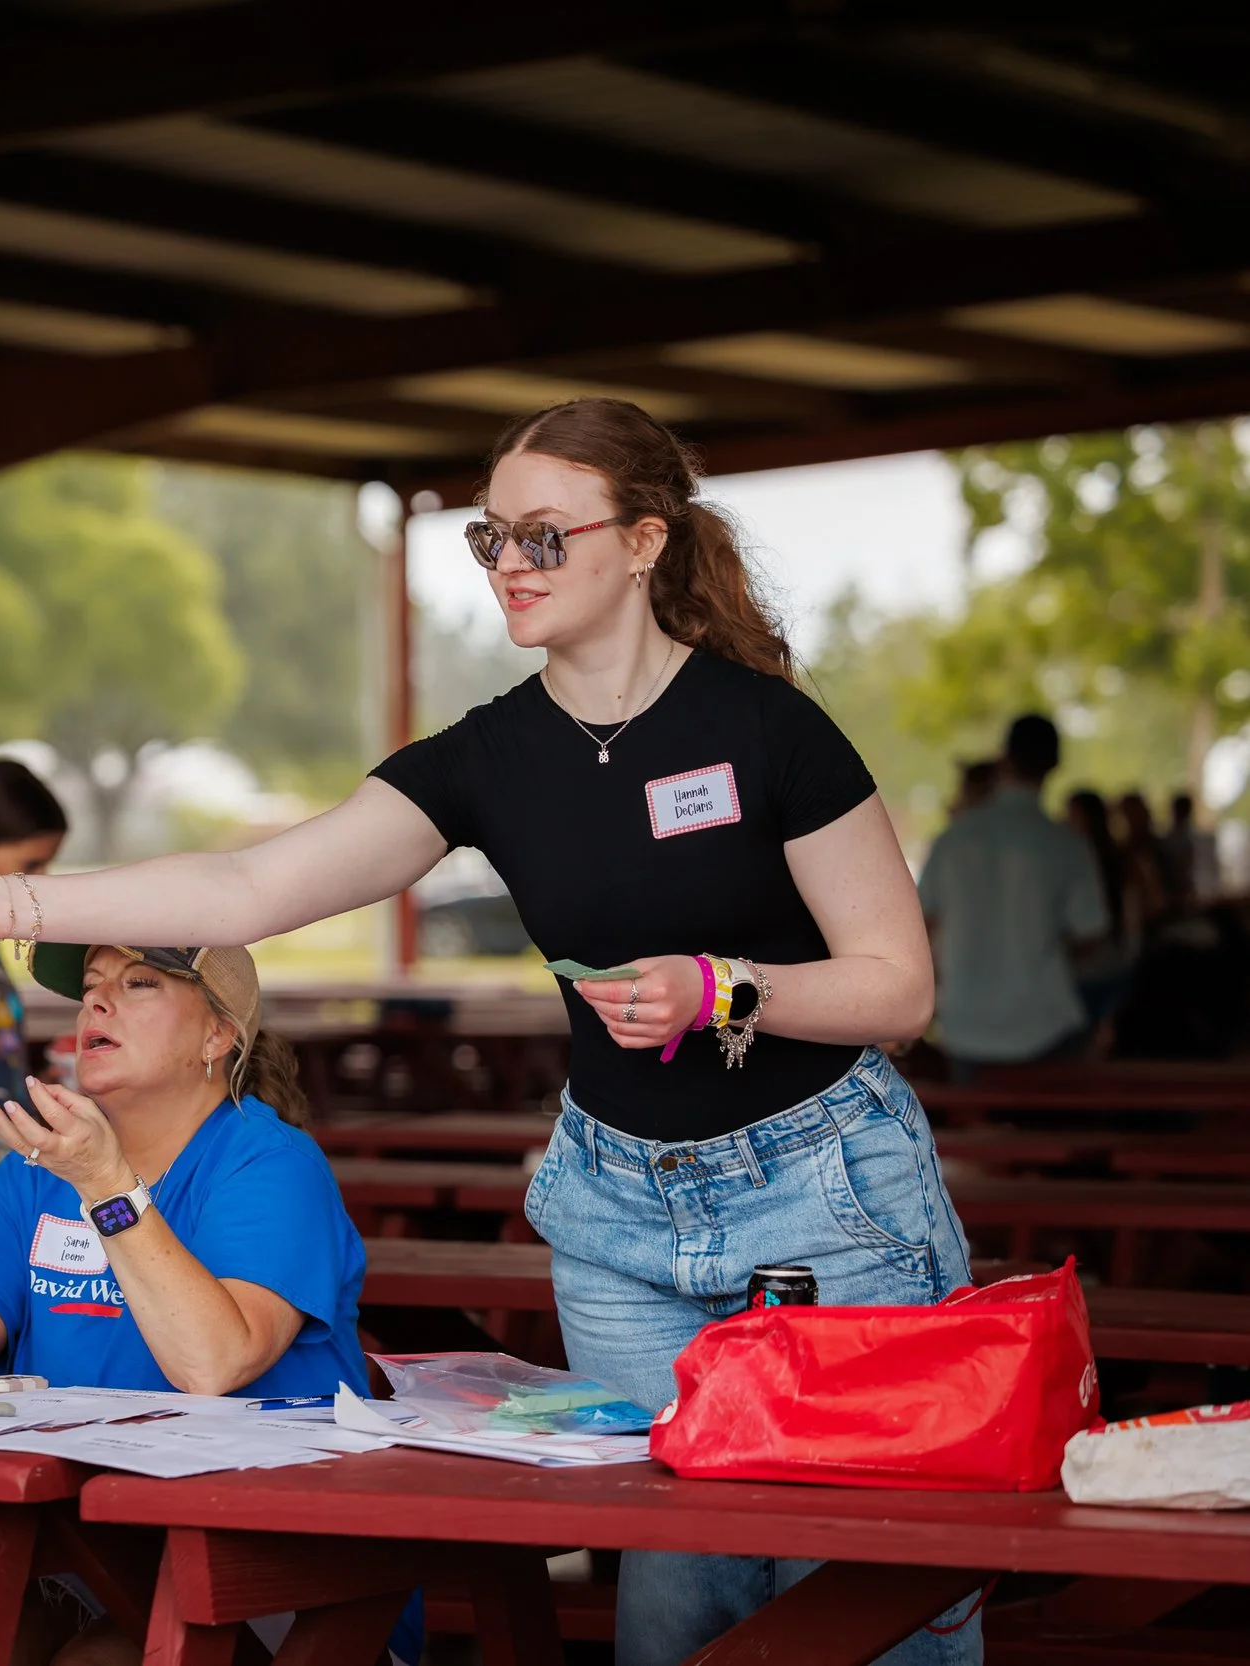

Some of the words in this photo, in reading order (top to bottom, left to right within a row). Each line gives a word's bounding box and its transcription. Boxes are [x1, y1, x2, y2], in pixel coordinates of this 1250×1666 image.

[673, 784, 709, 803] Hannah
[674, 800, 714, 819] DeClaris
[63, 1235, 90, 1249] Sarah
[60, 1249, 85, 1262] Leone
